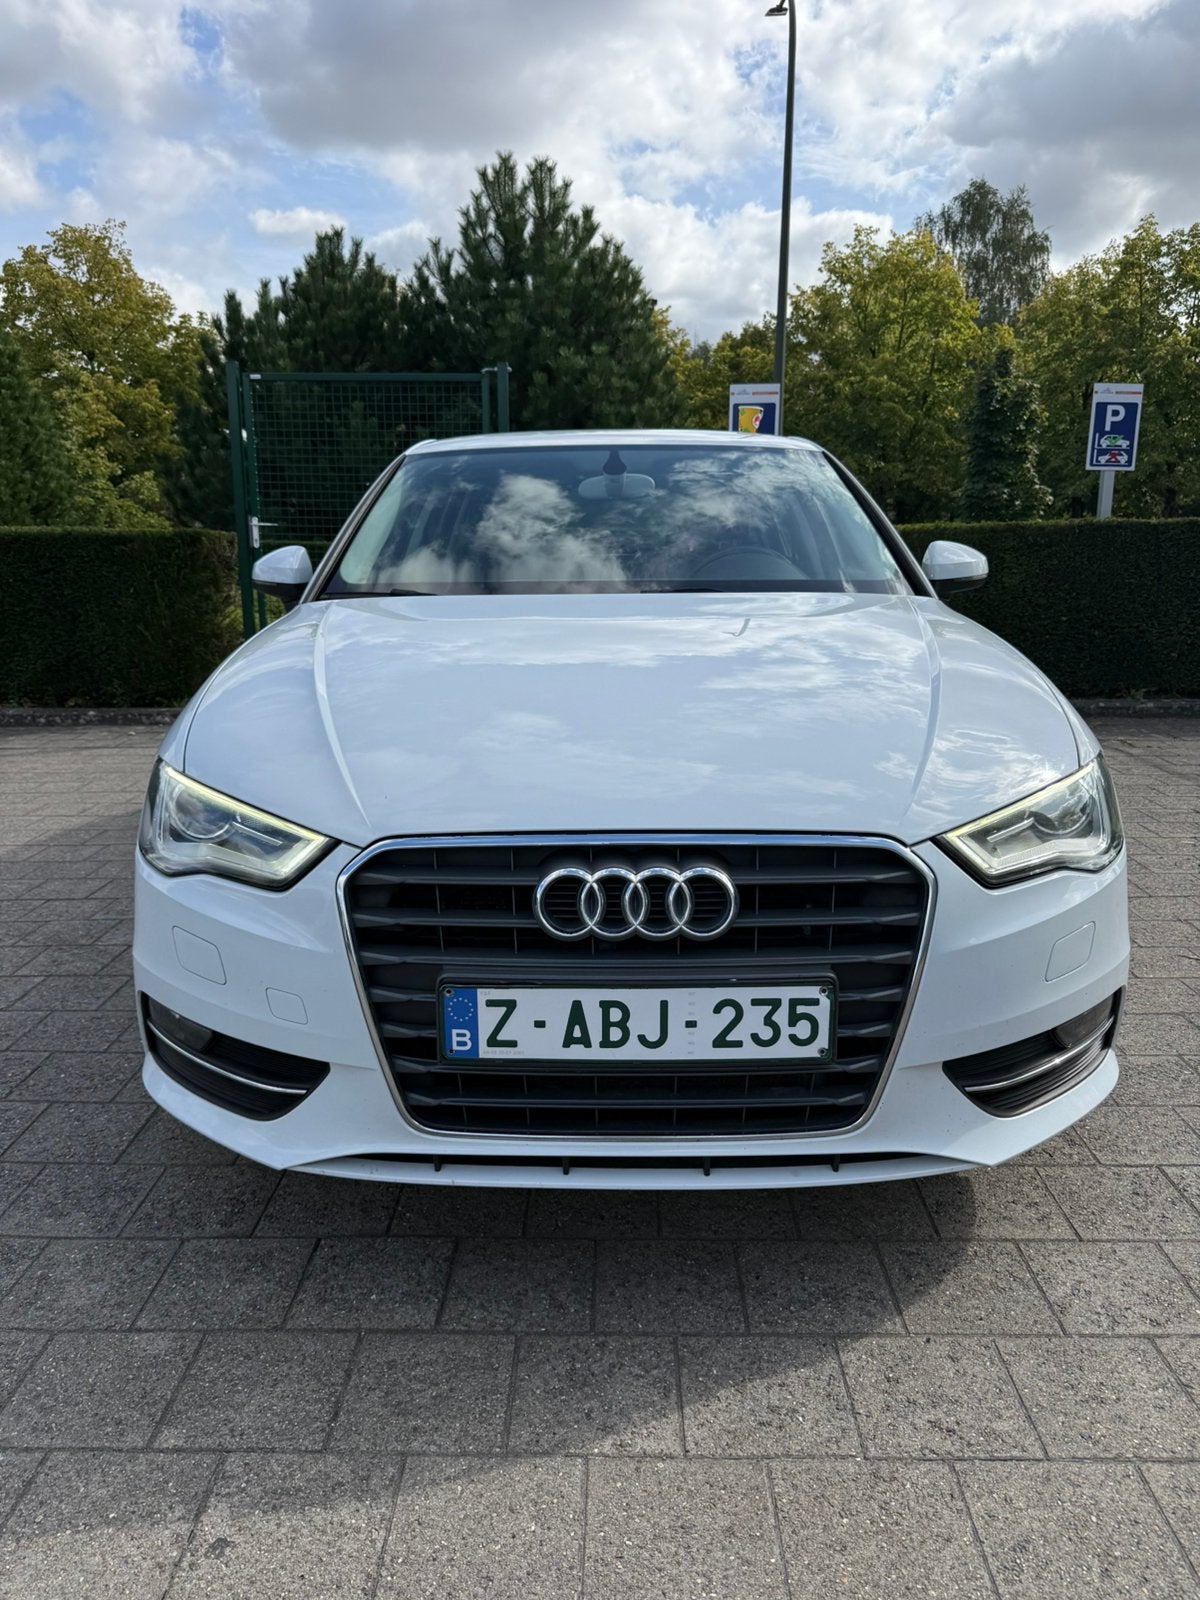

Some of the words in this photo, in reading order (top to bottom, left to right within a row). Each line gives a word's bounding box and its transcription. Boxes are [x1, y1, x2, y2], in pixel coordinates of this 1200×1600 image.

[1104, 404, 1126, 432] P
[485, 998, 820, 1050] Z-ABJ-235
[451, 1029, 473, 1051] B
